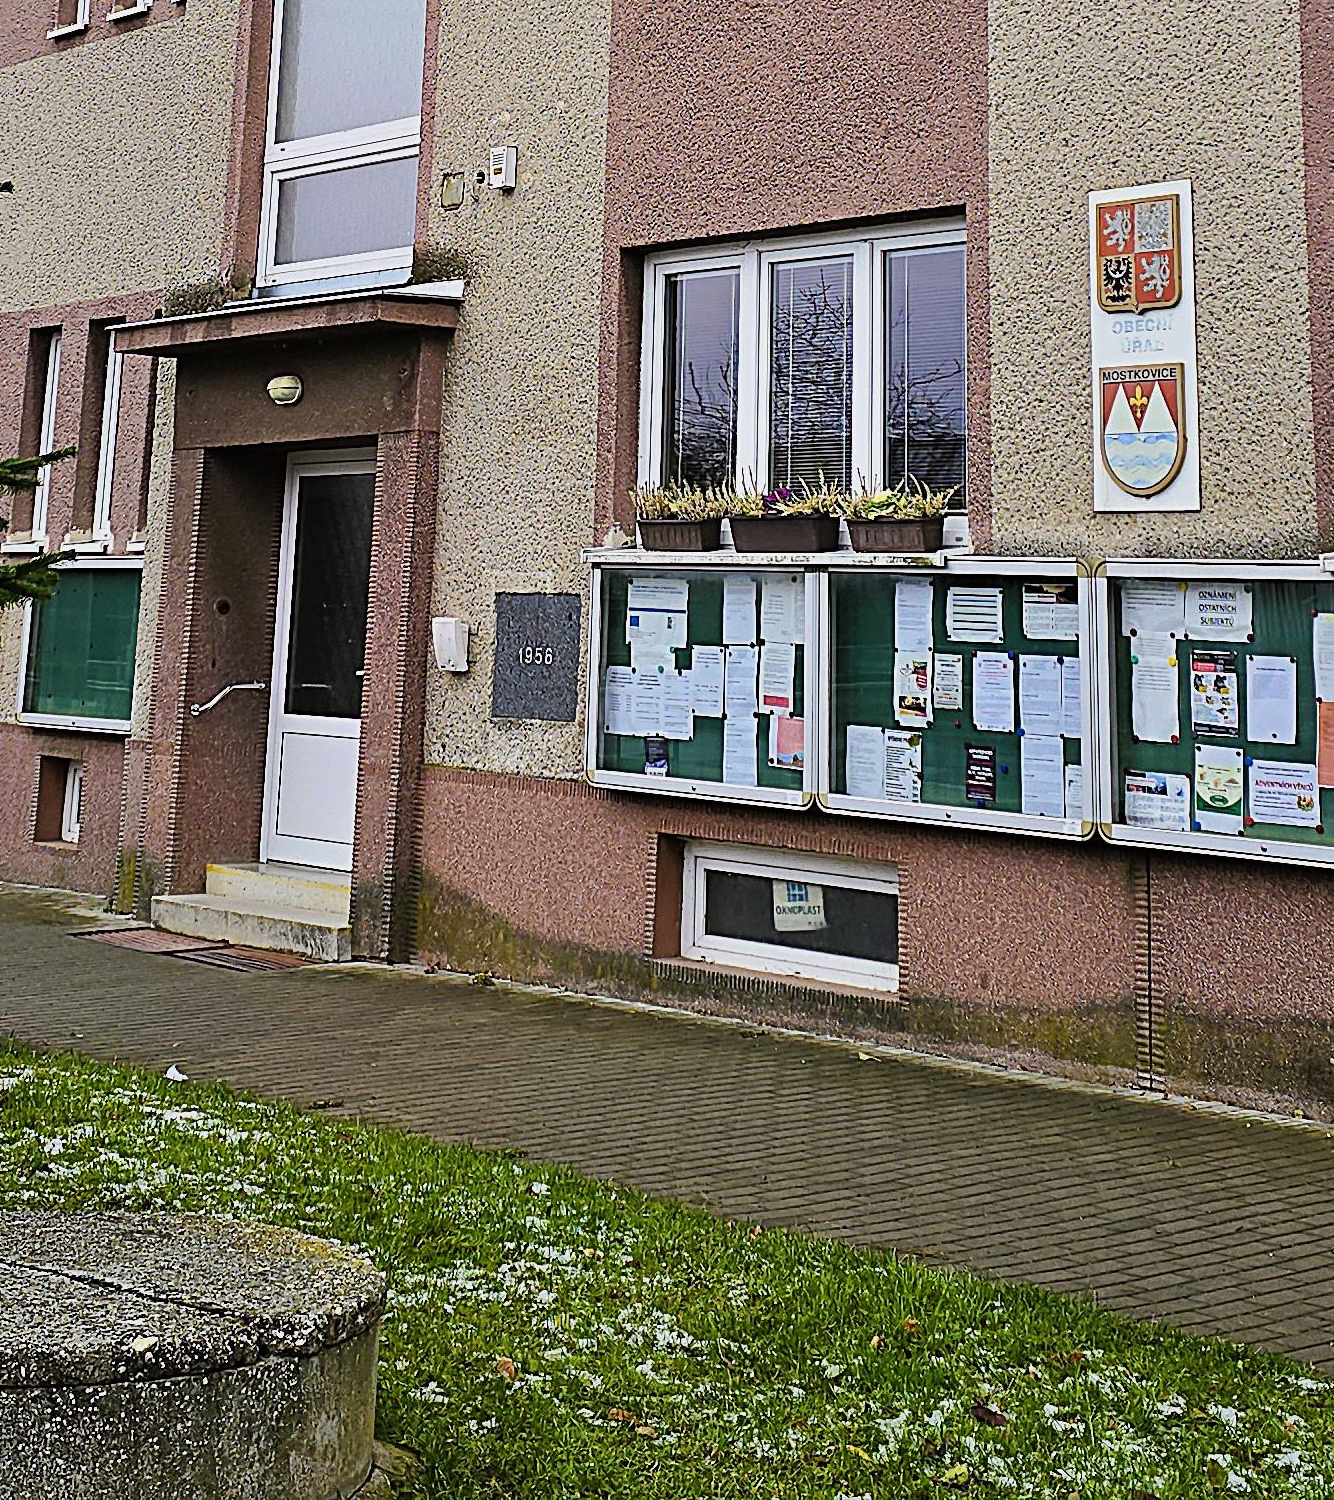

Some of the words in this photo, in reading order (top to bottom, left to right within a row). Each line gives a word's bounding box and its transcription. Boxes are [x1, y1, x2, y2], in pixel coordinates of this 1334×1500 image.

[1102, 367, 1177, 381] MOSTKOVICE
[1198, 603, 1237, 613] OSTATNÍCH
[518, 646, 553, 665] 1956
[775, 905, 820, 915] OKNOPLAST
